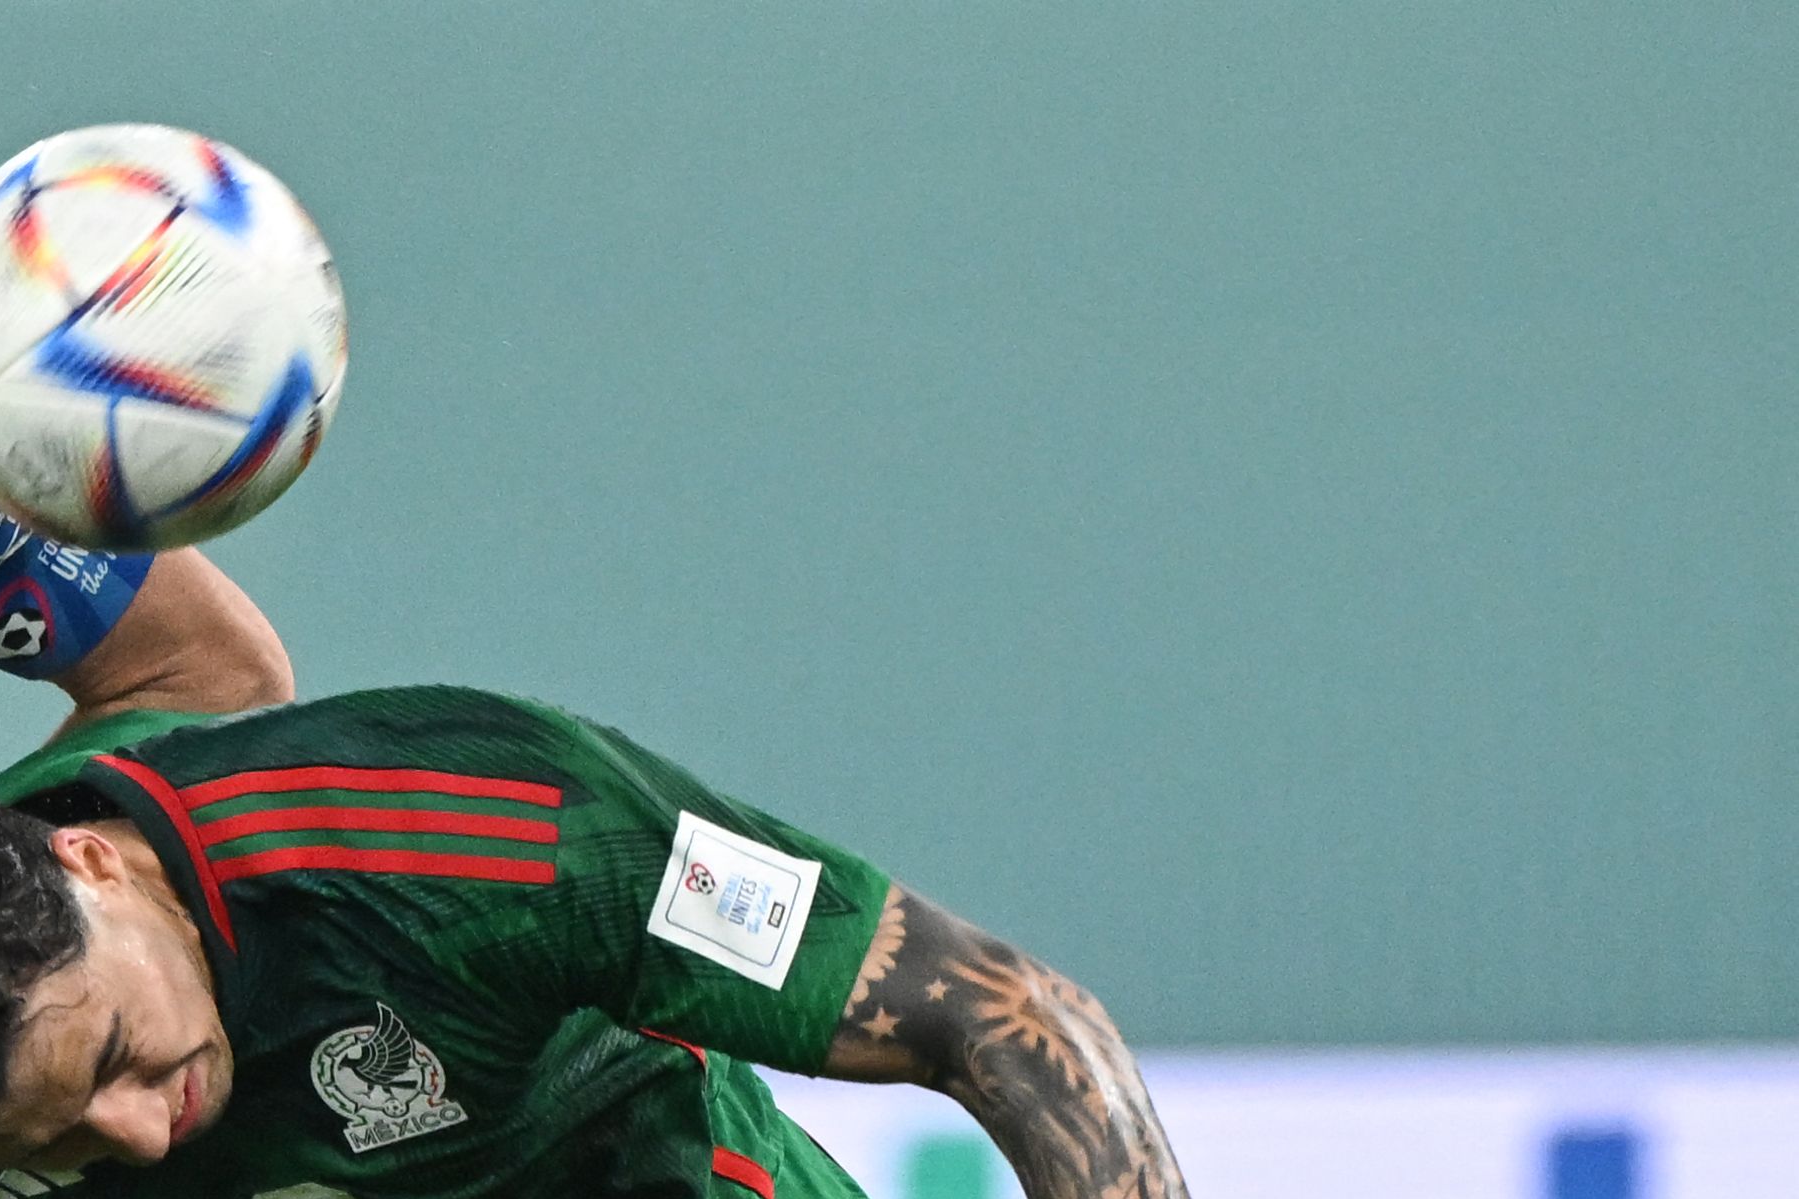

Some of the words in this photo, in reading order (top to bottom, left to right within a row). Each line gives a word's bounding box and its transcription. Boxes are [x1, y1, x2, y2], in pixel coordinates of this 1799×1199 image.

[80, 560, 109, 595] the
[728, 877, 758, 926] UNITES
[350, 1105, 462, 1149] MEXICO
